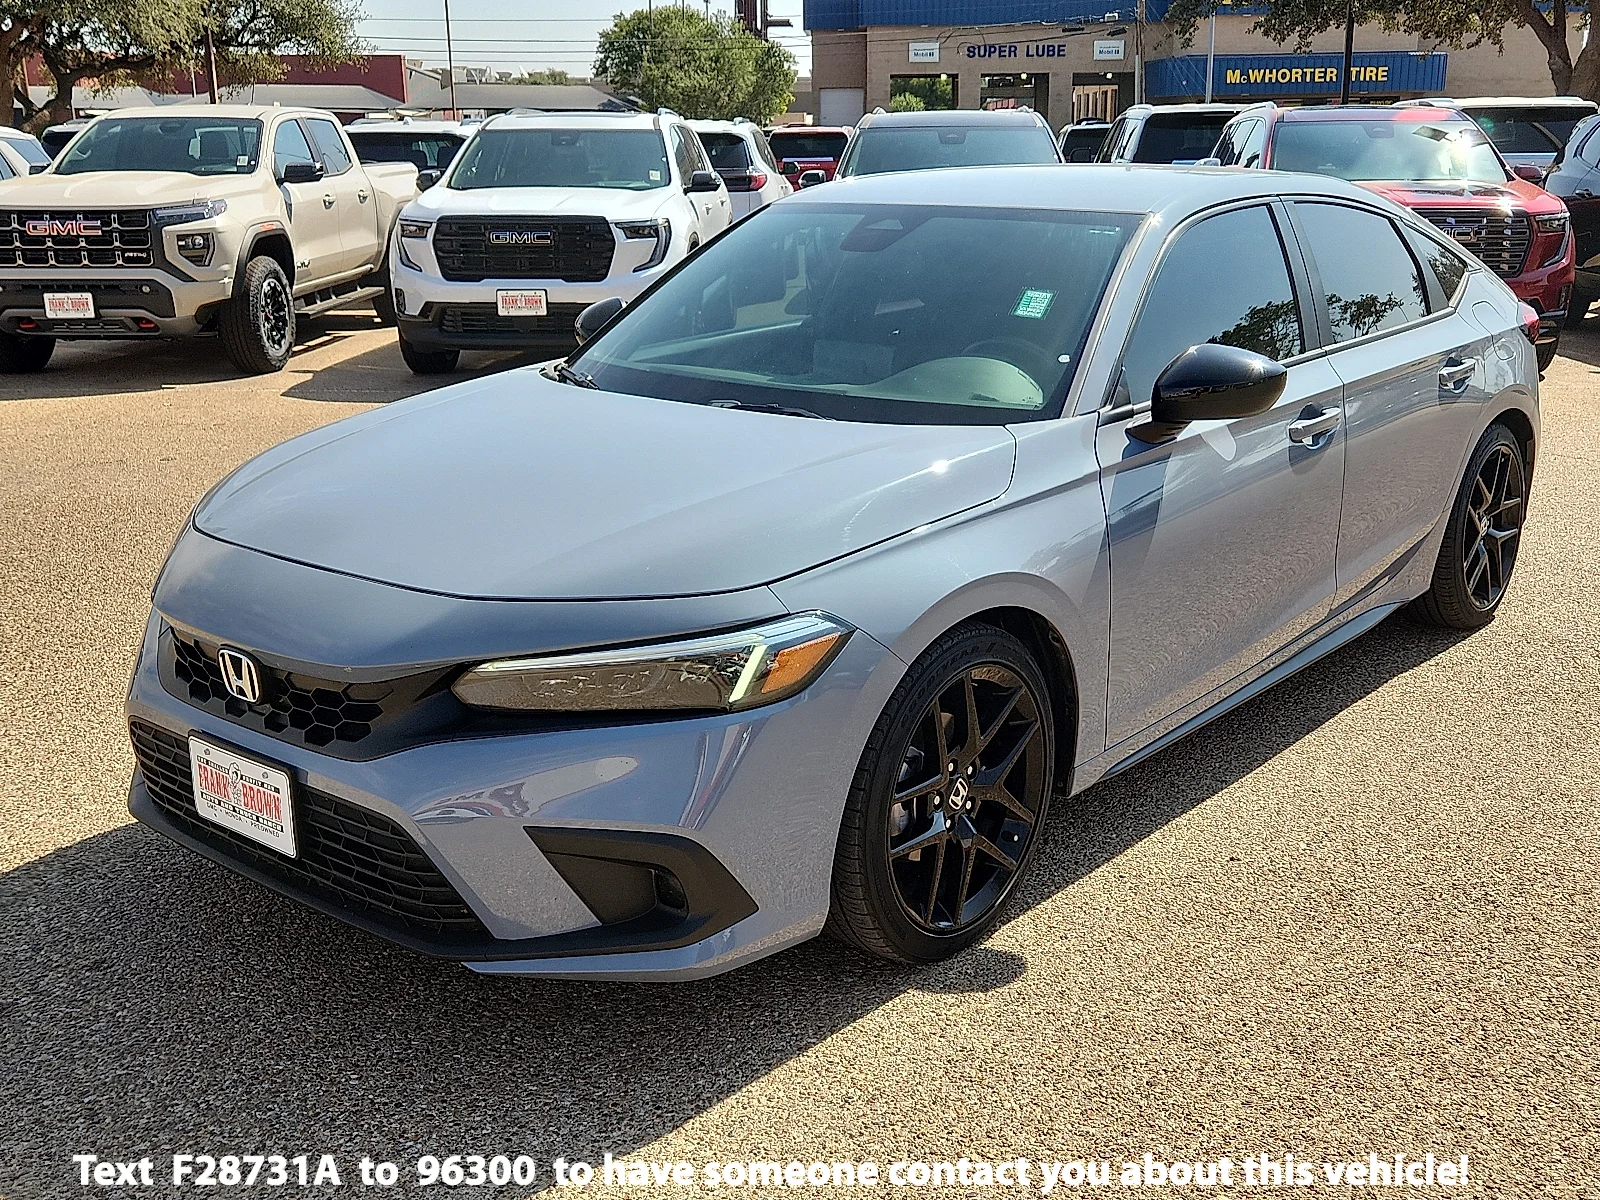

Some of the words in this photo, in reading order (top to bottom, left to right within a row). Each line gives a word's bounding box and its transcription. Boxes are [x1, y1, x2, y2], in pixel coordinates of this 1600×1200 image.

[966, 45, 1018, 59] SUPER
[1025, 44, 1067, 58] LUBE
[1226, 68, 1337, 84] McWHORTER
[1350, 66, 1389, 82] TIRE
[26, 219, 102, 236] GMC
[489, 231, 551, 244] GMC
[197, 763, 231, 800] FRANK
[241, 781, 283, 823] BROWN
[203, 793, 219, 805] AUTO
[220, 800, 234, 811] AND
[250, 820, 280, 838] PREOWNED
